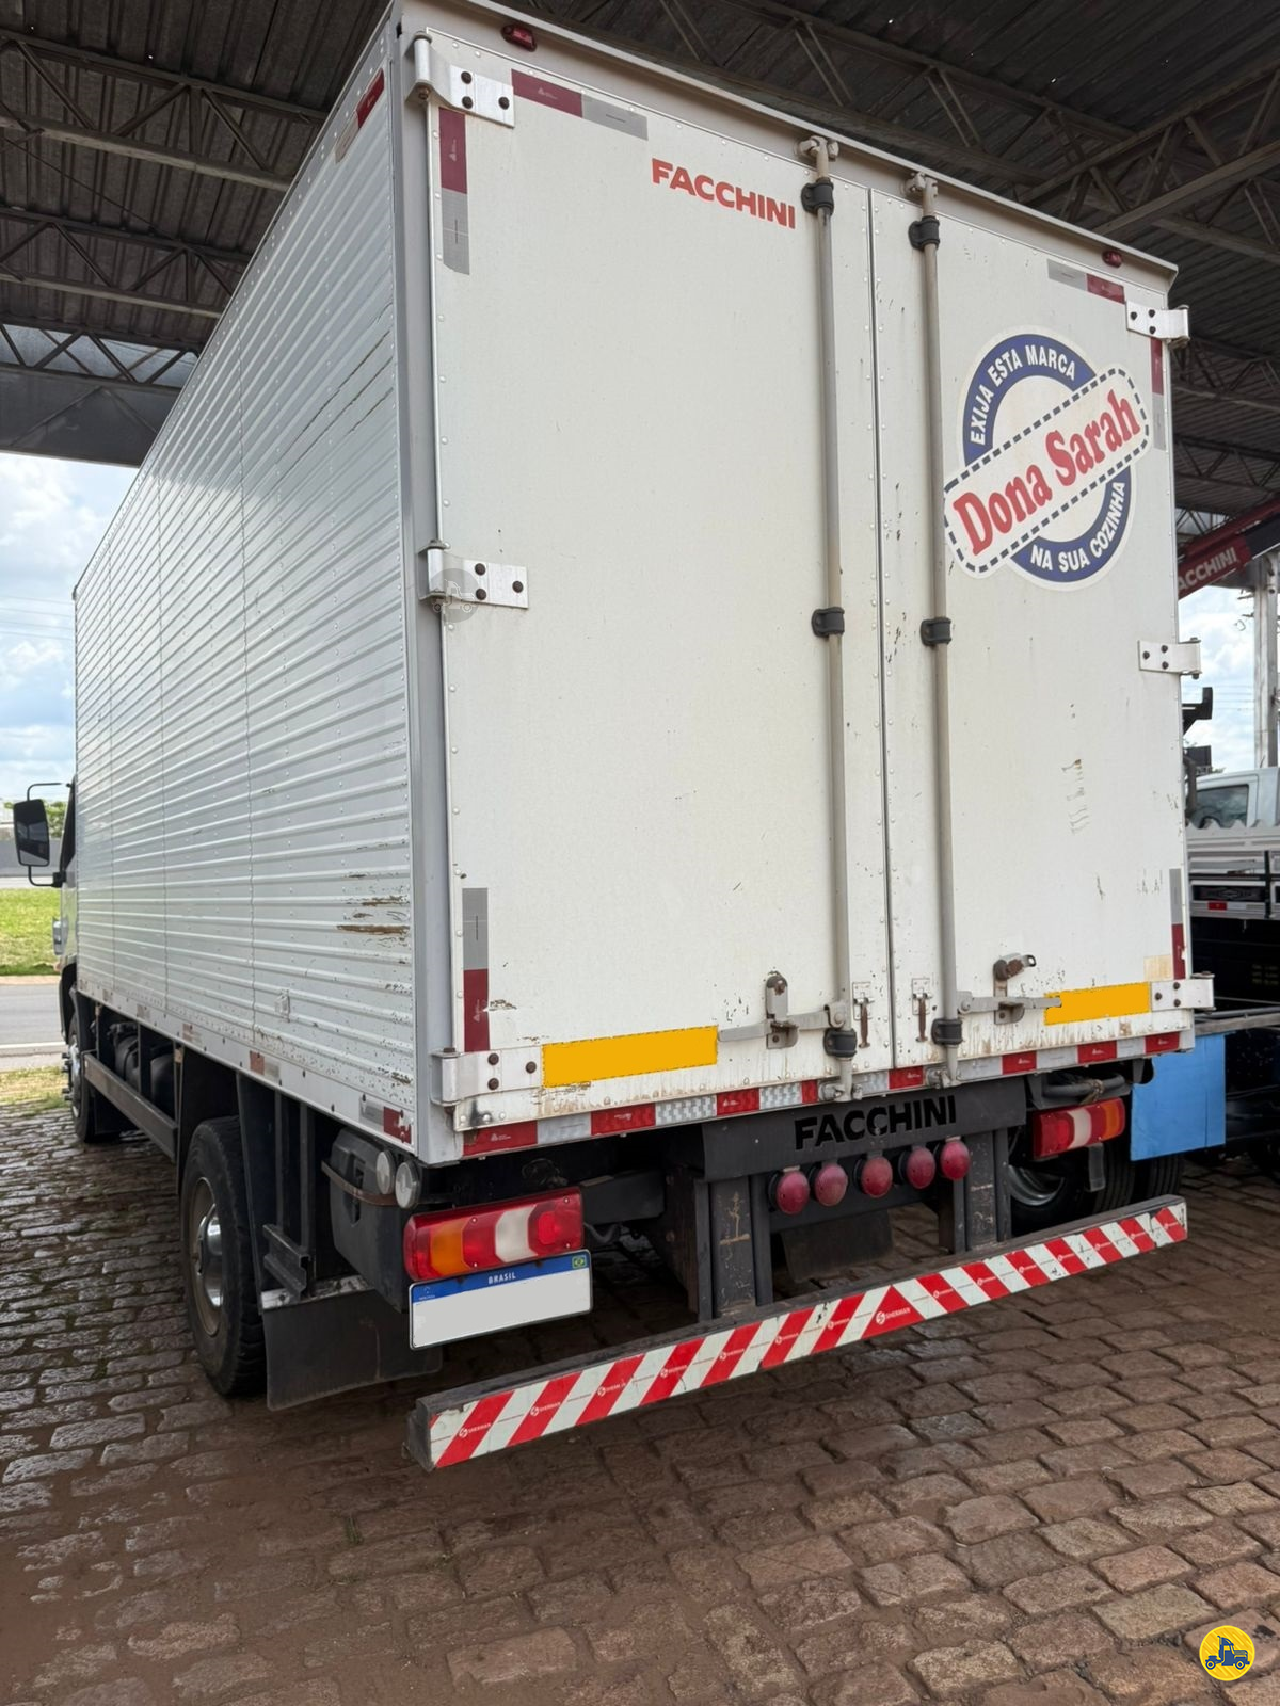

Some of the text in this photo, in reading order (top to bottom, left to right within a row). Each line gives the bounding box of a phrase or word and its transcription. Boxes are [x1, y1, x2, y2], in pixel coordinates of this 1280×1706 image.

[652, 157, 796, 229] FACCHINI
[970, 344, 1076, 446] EXIJA ESTA MARCA
[953, 389, 1141, 557] Dona Sarah
[1030, 481, 1125, 573] NA SUA COZINHA
[1178, 547, 1237, 591] ACCHINI
[794, 1095, 957, 1150] FACCHINI
[488, 1272, 516, 1285] BRASIL
